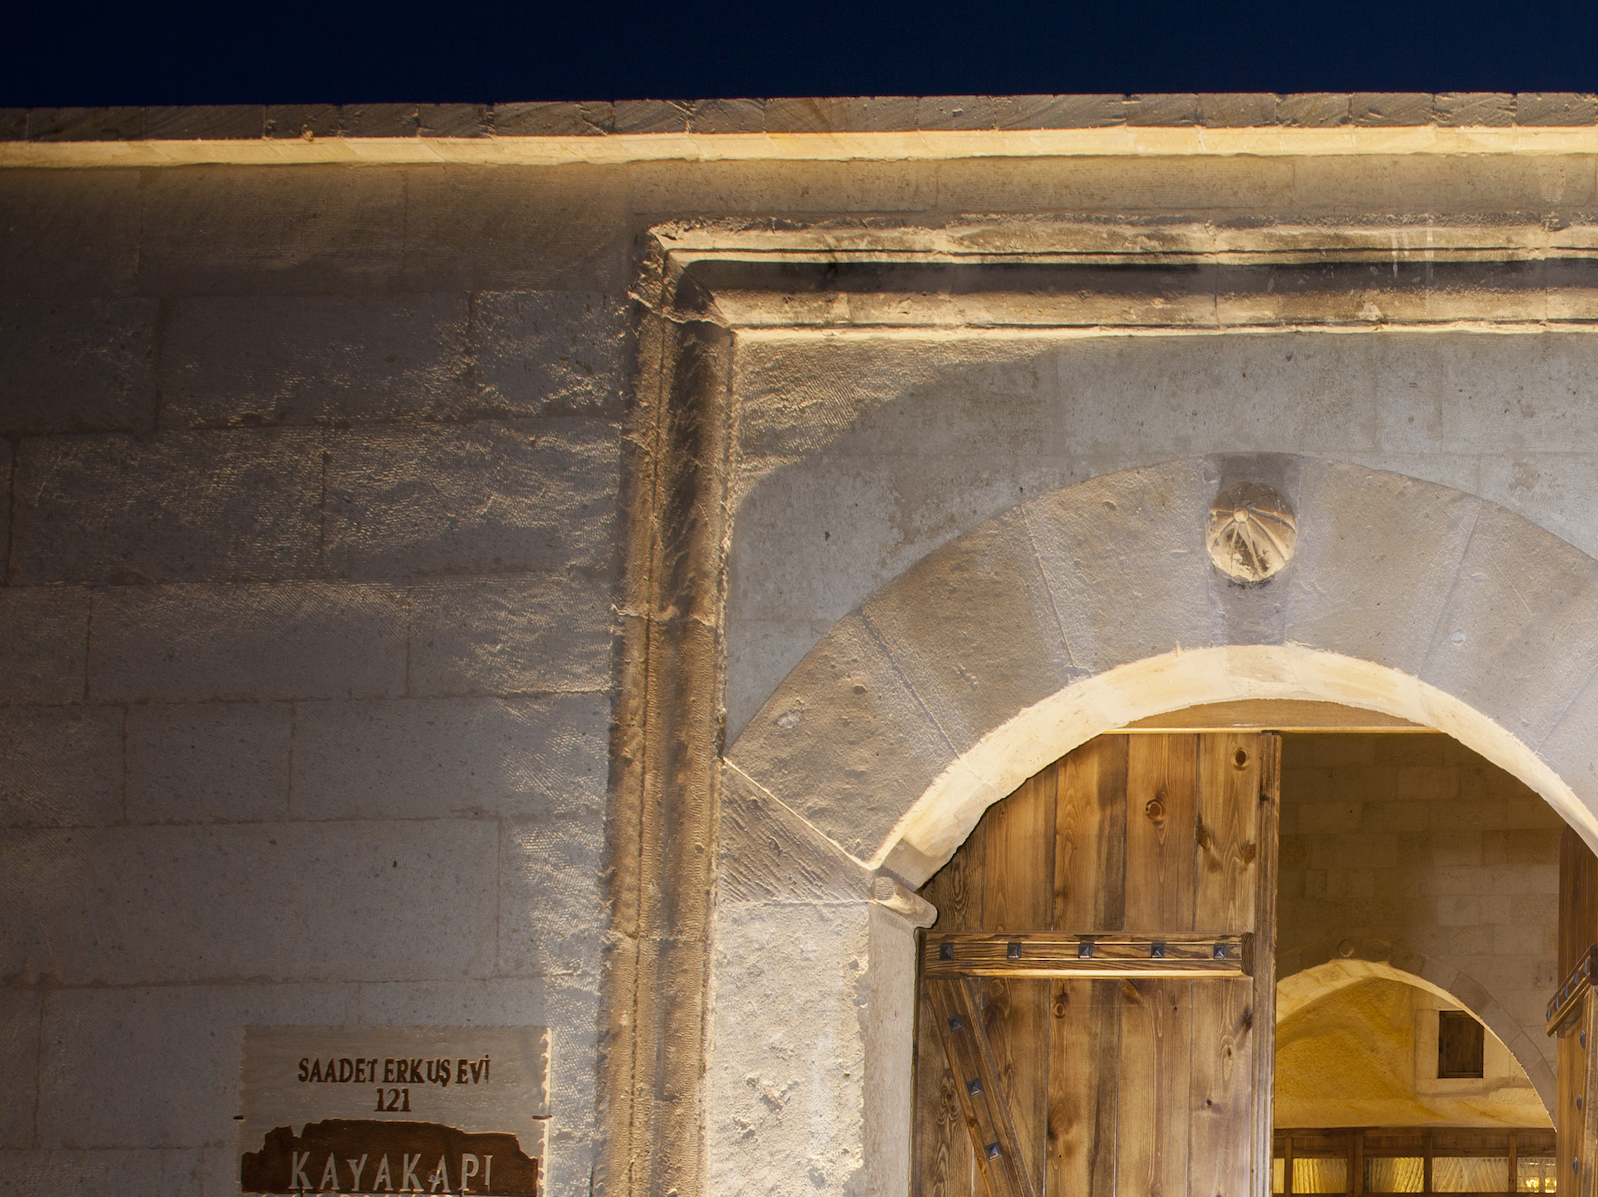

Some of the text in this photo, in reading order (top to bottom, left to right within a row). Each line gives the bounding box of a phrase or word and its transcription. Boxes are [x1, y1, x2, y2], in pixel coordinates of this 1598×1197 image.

[298, 1054, 490, 1087] SAADET ERKUŞ EVİ
[374, 1088, 411, 1113] 121
[289, 1152, 493, 1192] KAYAKAPI
